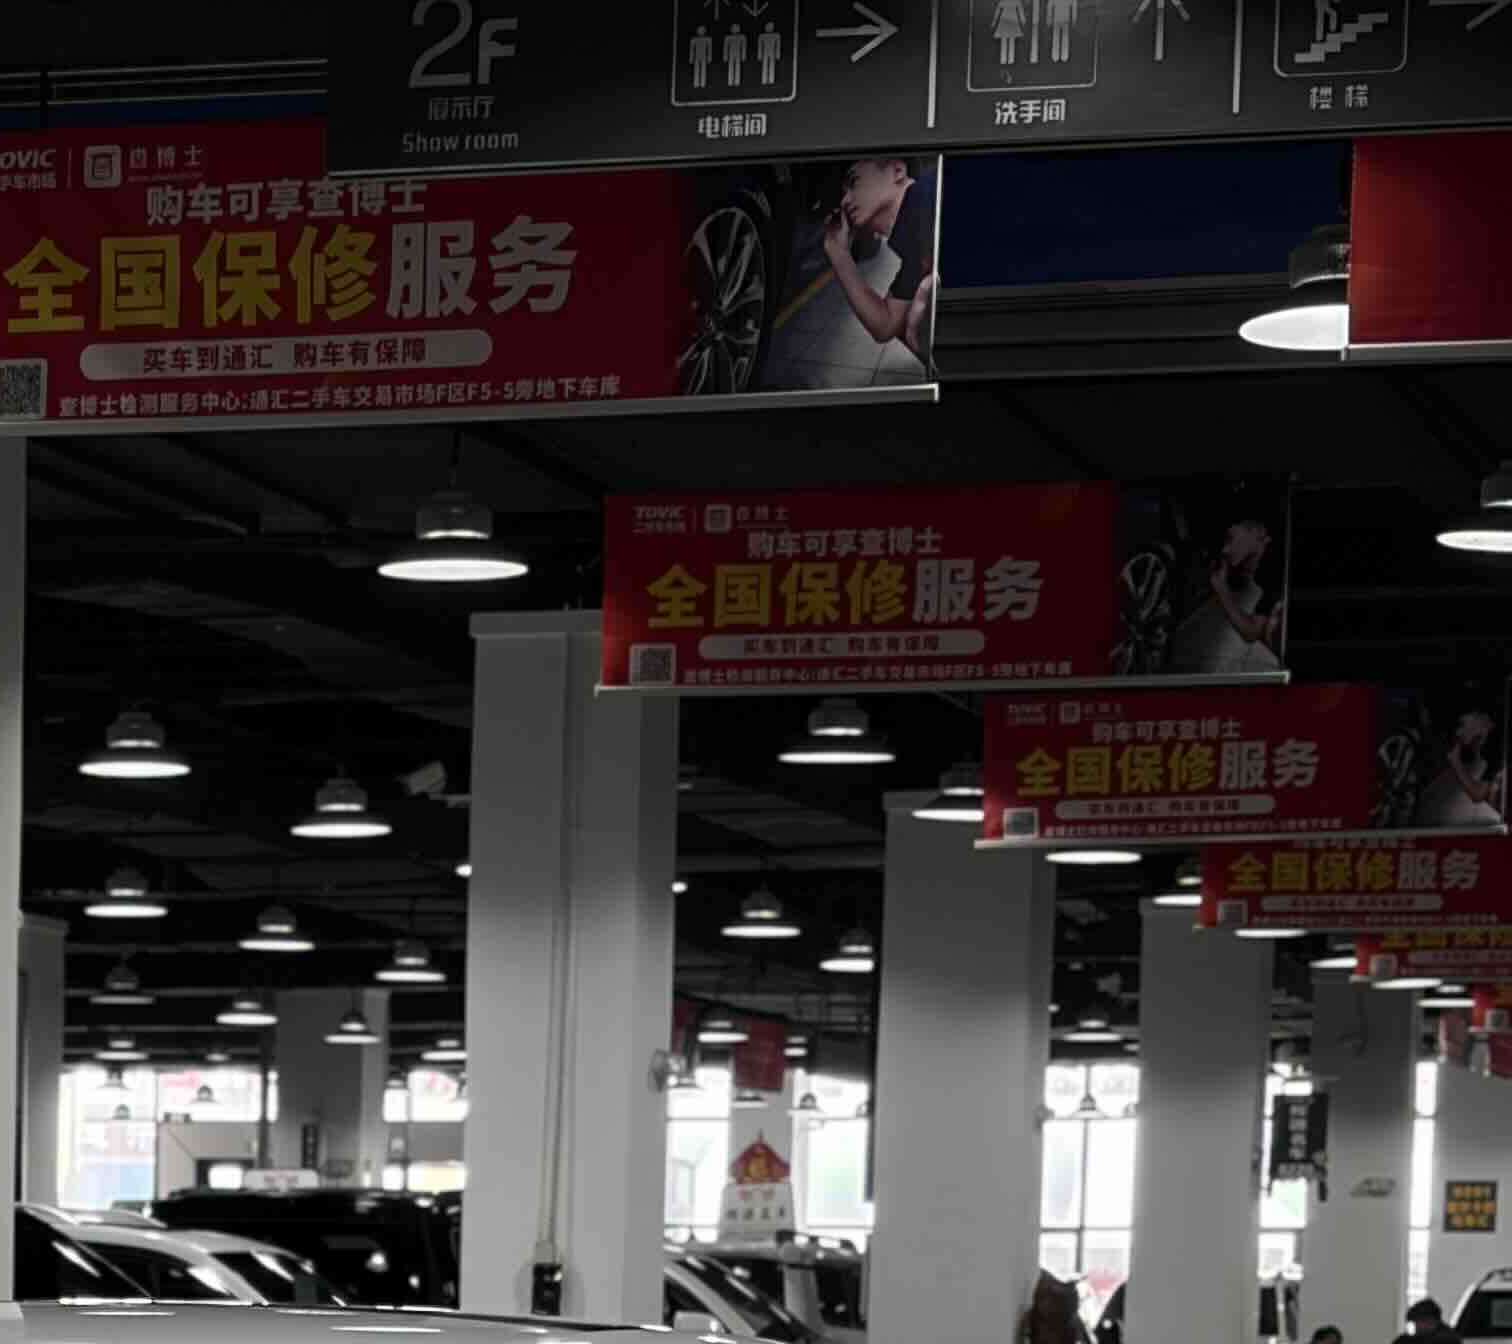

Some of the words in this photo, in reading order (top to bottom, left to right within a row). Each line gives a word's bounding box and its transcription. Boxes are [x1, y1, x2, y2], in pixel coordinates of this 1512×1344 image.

[407, 0, 520, 88] 2F
[698, 113, 767, 139] 电梯间
[994, 98, 1066, 126] 洗手间
[462, 130, 520, 151] room
[146, 178, 428, 226] 购车可享查博士
[4, 214, 578, 334] 全国保修服务
[142, 342, 274, 373] 买车到通汇
[292, 337, 428, 368] 购车有保障
[645, 554, 1044, 629] 全国保修服务
[1015, 737, 1320, 797] 全国保修服务
